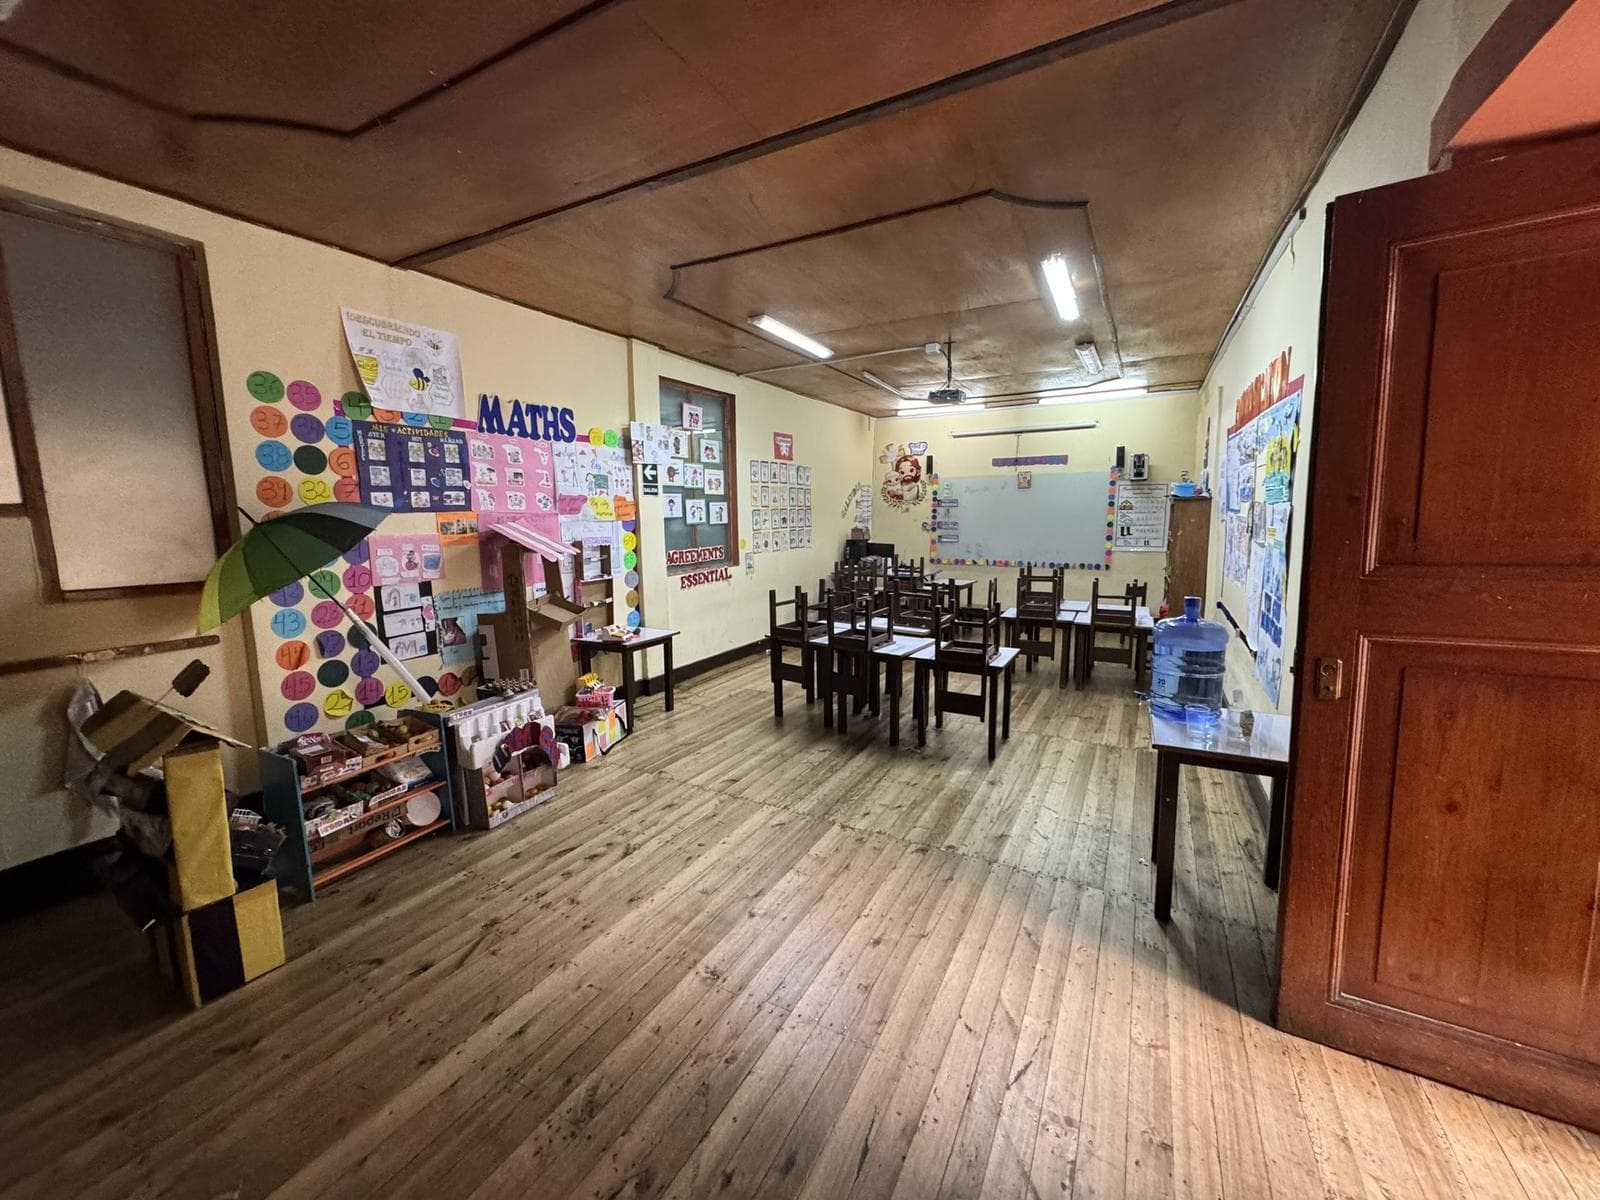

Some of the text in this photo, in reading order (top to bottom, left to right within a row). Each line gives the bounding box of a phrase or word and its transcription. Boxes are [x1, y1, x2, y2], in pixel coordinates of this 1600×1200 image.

[252, 373, 282, 396] 36
[256, 411, 284, 431] 37
[477, 393, 577, 443] MATHS
[334, 421, 351, 440] 5
[396, 427, 449, 438] ACTIVIDADES
[262, 444, 290, 466] 38
[337, 452, 352, 469] 6
[302, 480, 331, 500] 32
[666, 546, 725, 565] AGREEMENTS
[348, 571, 372, 588] 10
[680, 567, 732, 590] ESSENTIAL
[273, 612, 301, 634] 43
[388, 684, 408, 706] 15
